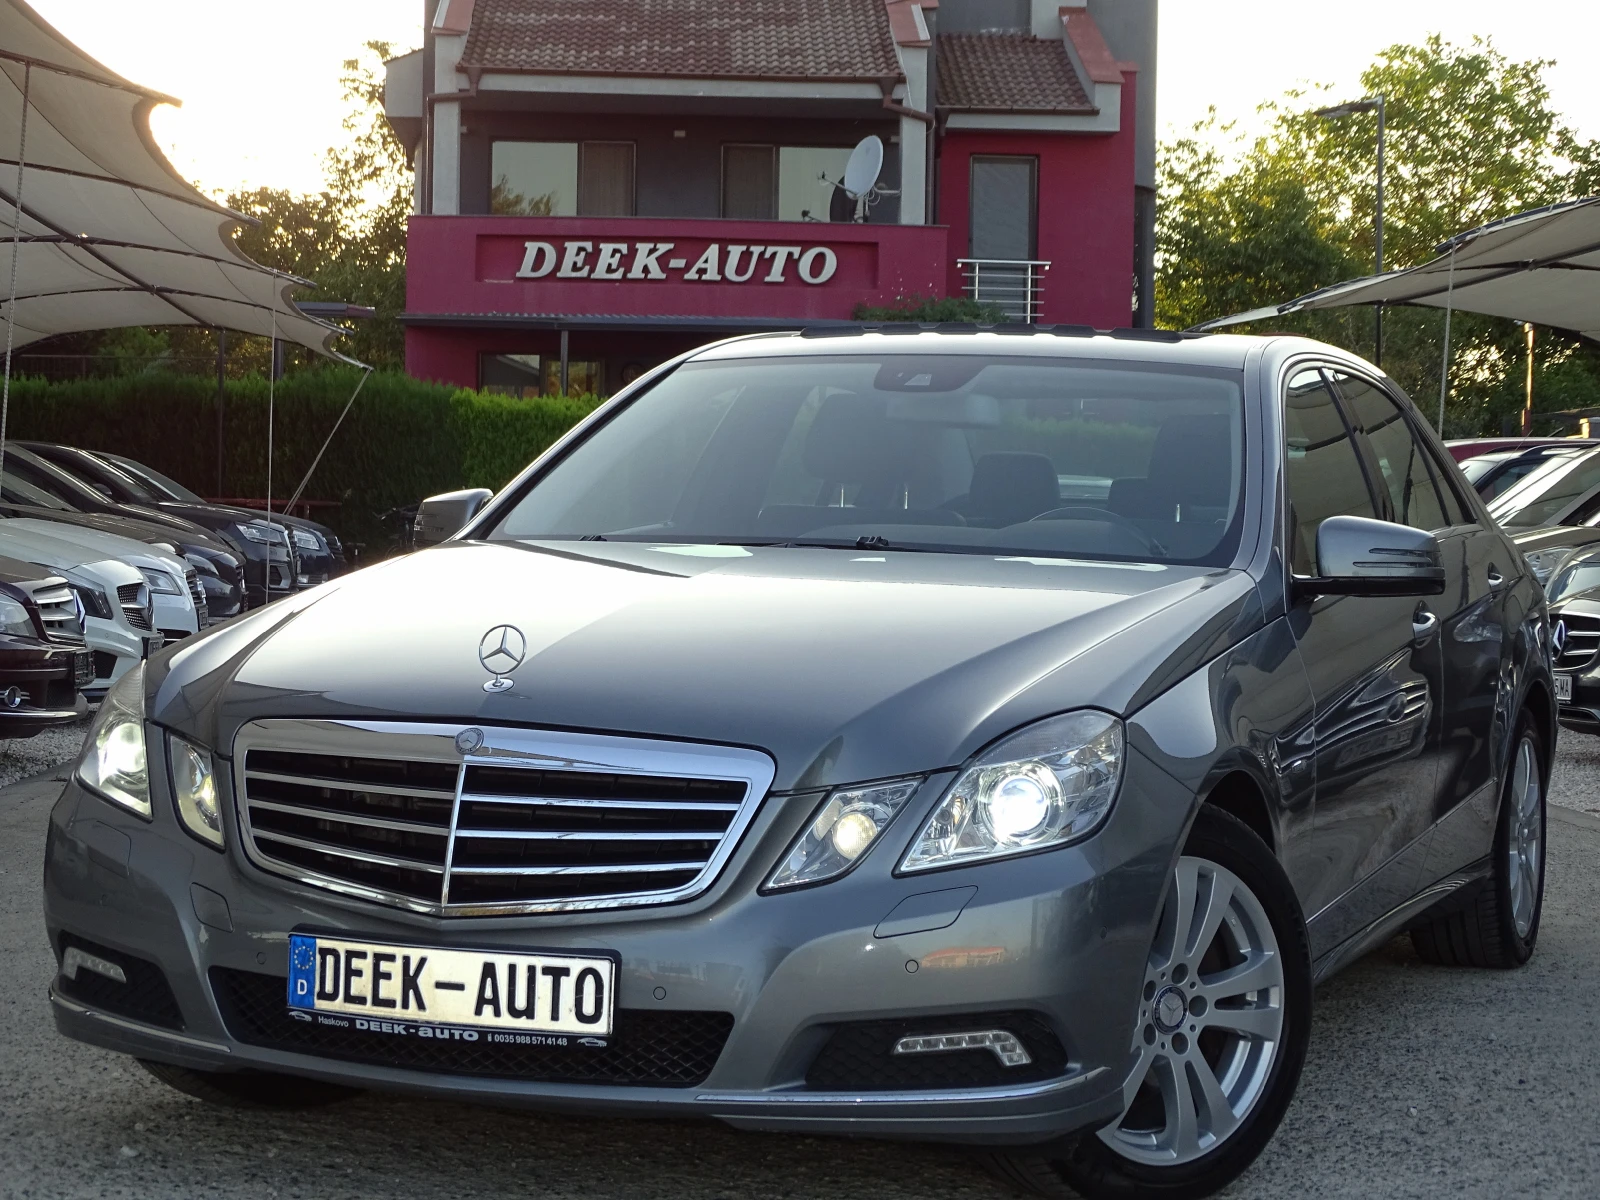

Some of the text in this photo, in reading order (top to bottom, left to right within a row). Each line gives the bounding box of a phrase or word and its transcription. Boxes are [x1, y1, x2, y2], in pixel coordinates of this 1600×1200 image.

[515, 241, 838, 284] DEEK-AUTO
[296, 979, 308, 995] D
[318, 1015, 350, 1028] Haskovo
